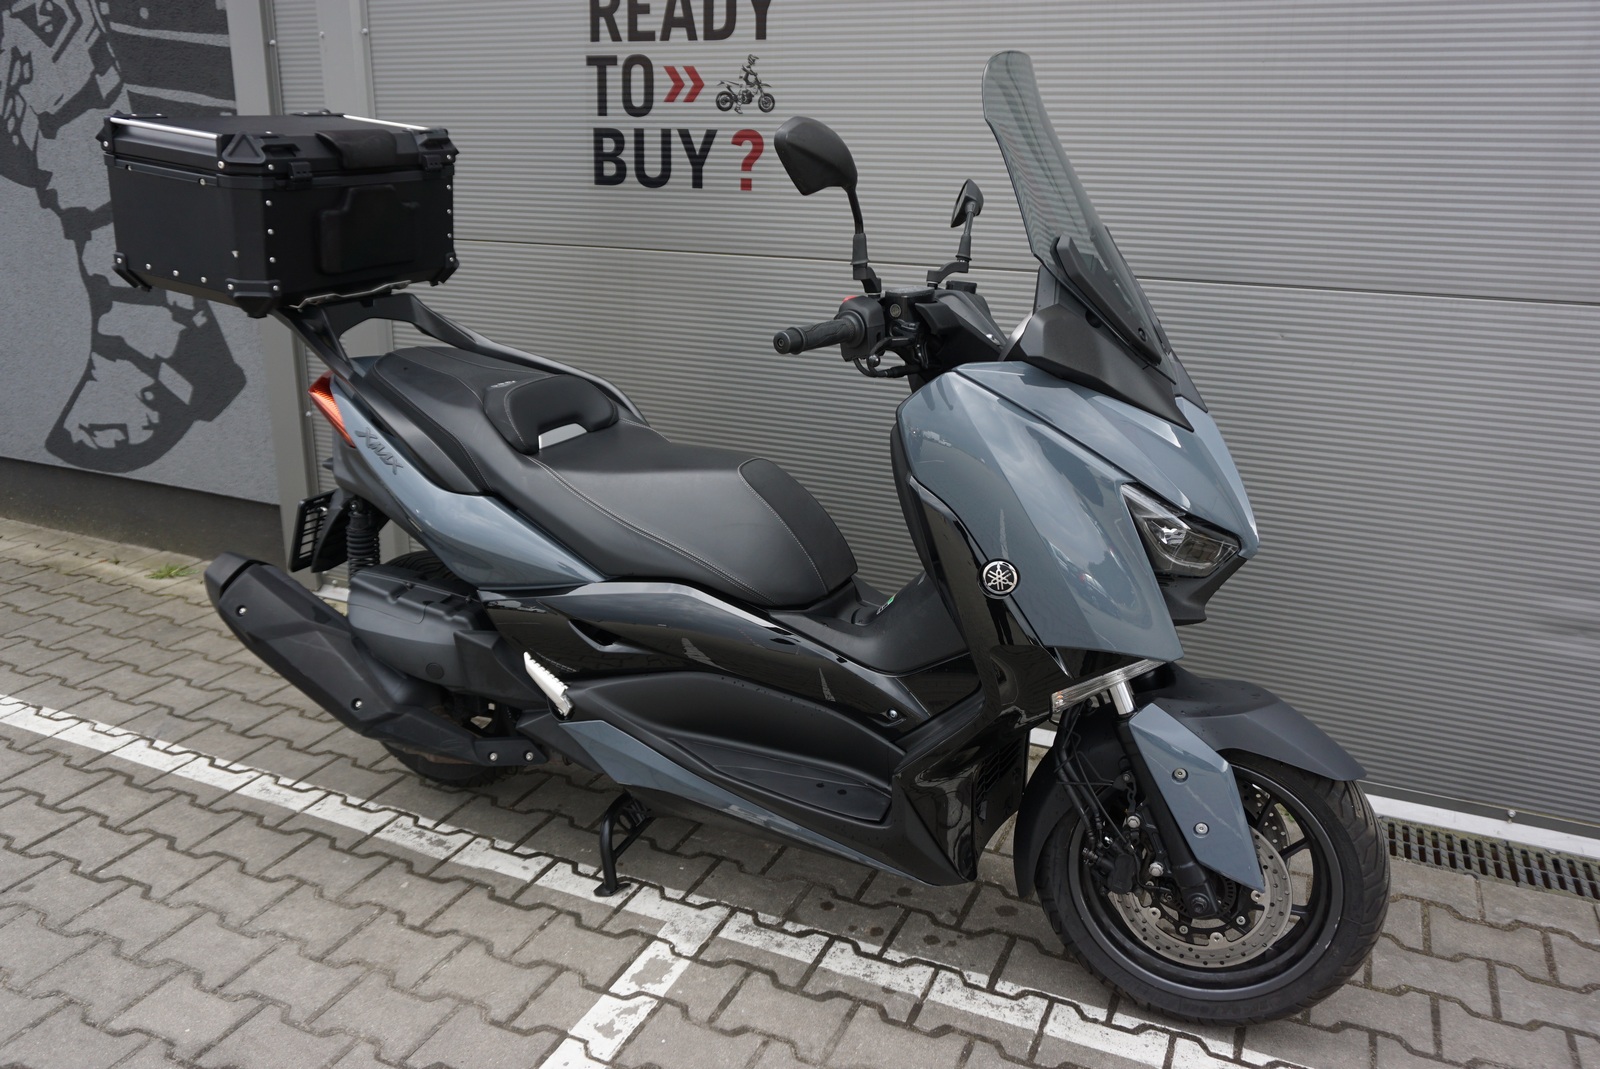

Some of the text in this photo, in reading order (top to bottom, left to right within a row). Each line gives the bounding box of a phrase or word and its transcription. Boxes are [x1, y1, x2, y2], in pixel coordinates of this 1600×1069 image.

[590, 0, 772, 42] READY
[586, 54, 654, 118] TO
[354, 427, 404, 476] XMAX
